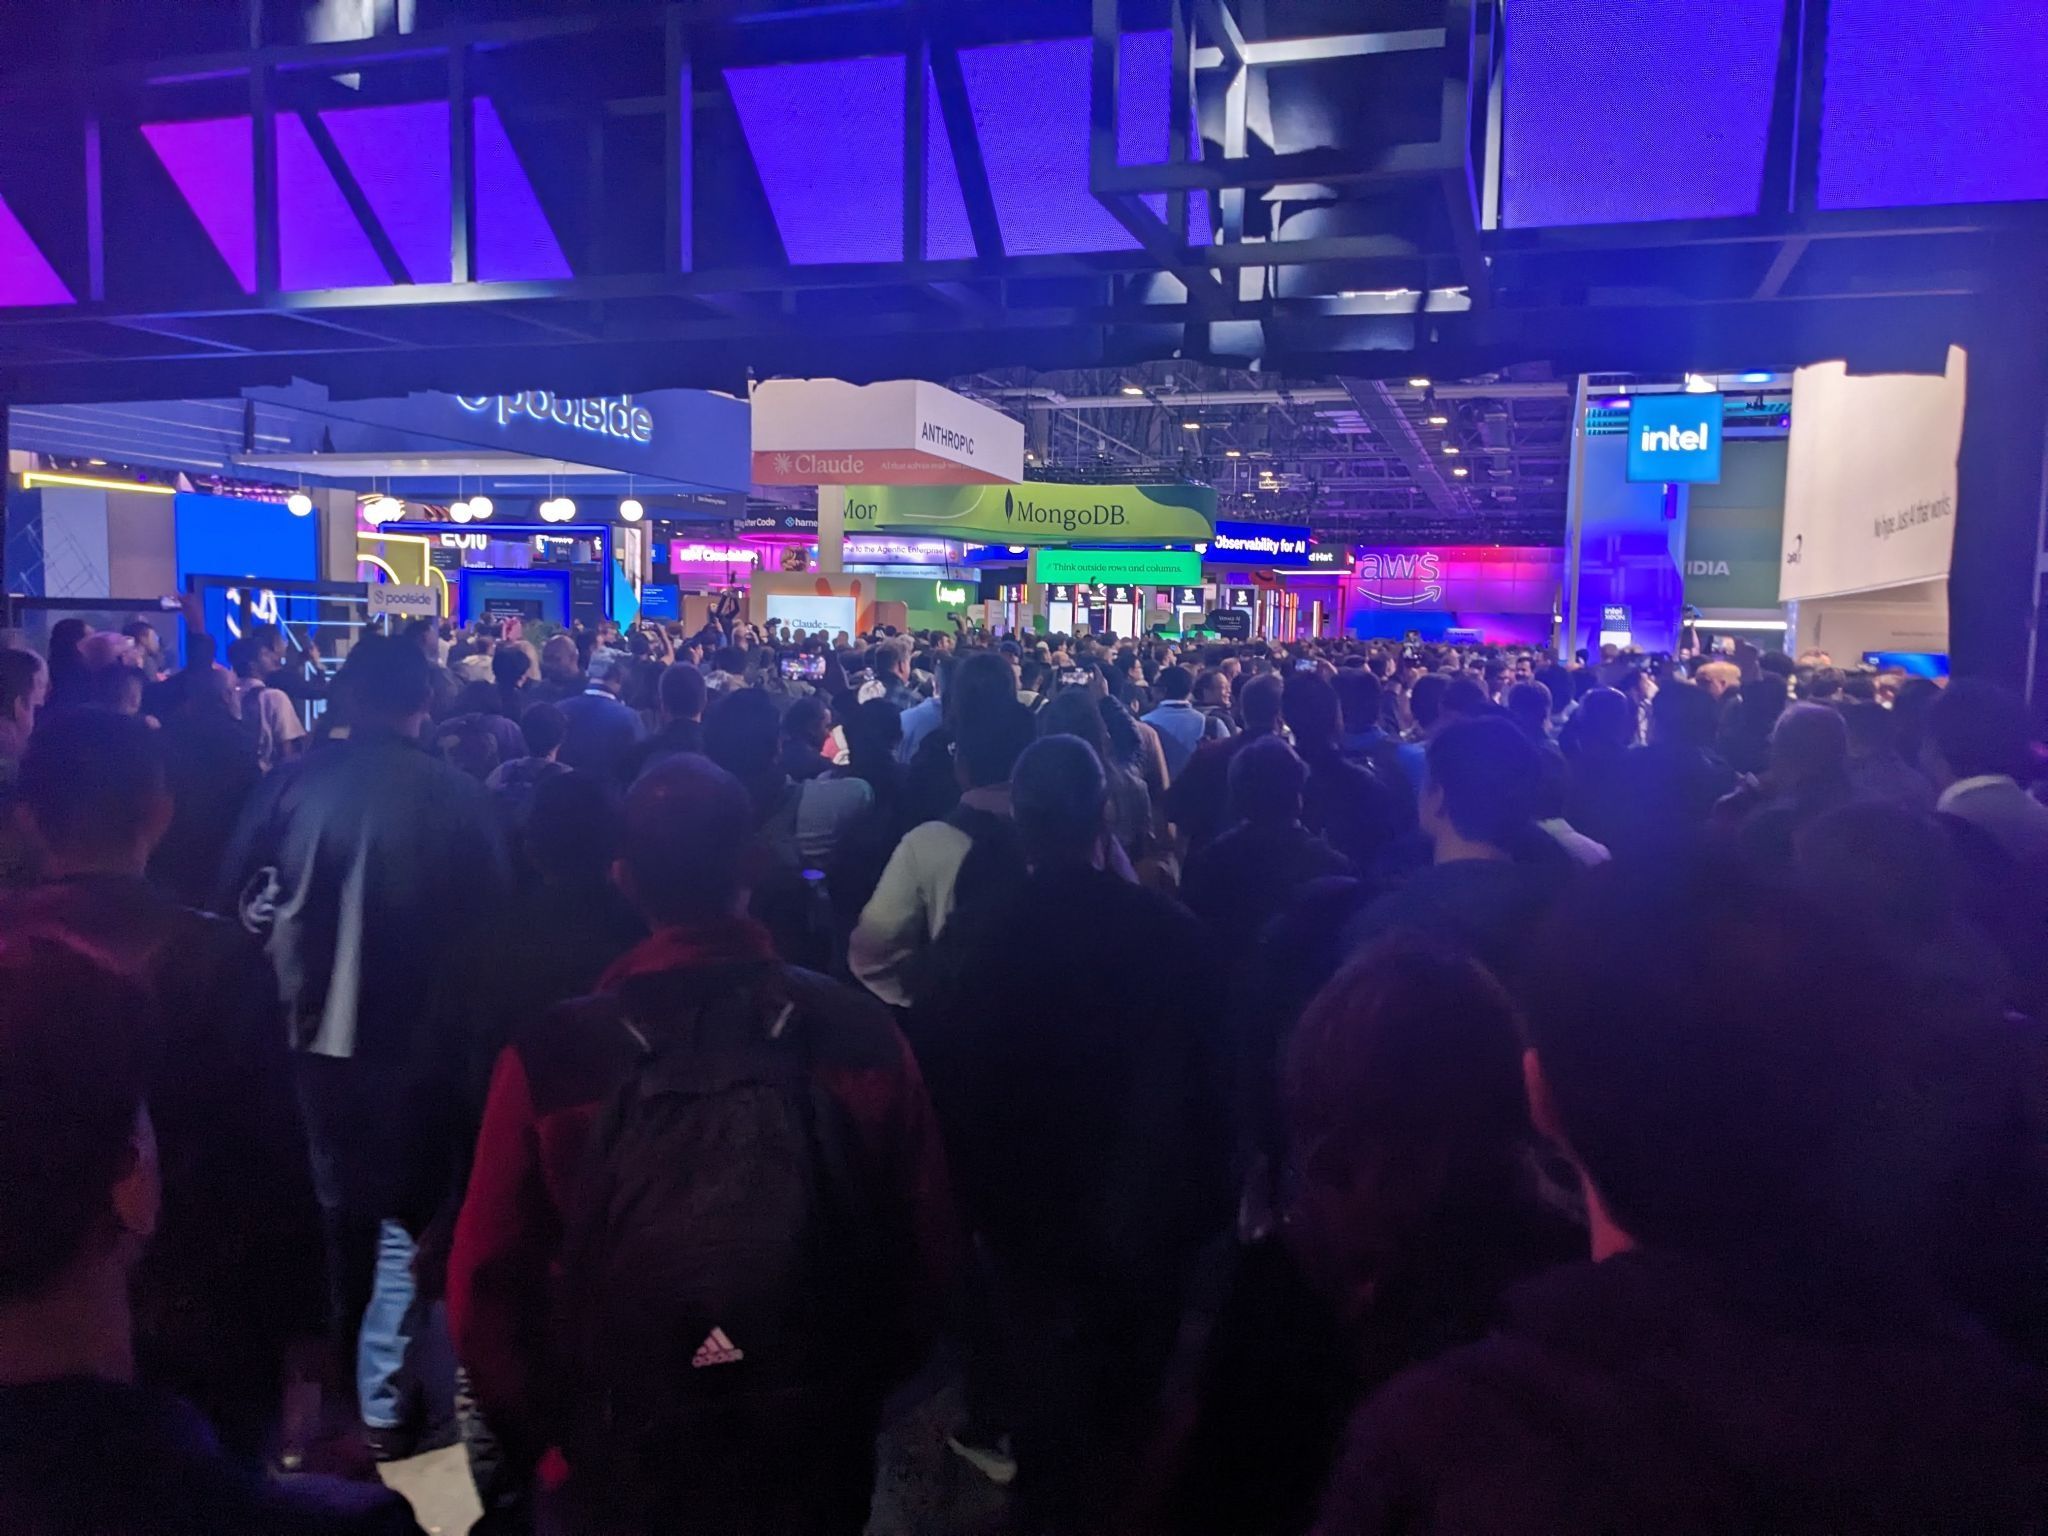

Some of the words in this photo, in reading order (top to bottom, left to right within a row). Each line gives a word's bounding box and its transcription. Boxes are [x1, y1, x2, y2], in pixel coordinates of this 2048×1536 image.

[498, 391, 653, 442] poolside
[1641, 422, 1708, 452] intel
[795, 454, 864, 475] Claude
[757, 517, 776, 527] Code
[1018, 501, 1125, 531] MongoDB
[877, 546, 906, 554] Agentic
[907, 546, 943, 555] Enterprise
[1214, 534, 1279, 556] Observability
[1280, 539, 1294, 553] for
[1295, 541, 1305, 554] AI
[1053, 562, 1076, 571] Think
[1078, 563, 1107, 572] outside
[1128, 564, 1145, 573] and
[1145, 563, 1183, 573] columns.
[1361, 552, 1440, 583] aws
[385, 592, 432, 605] poolside
[792, 619, 822, 629] Claude
